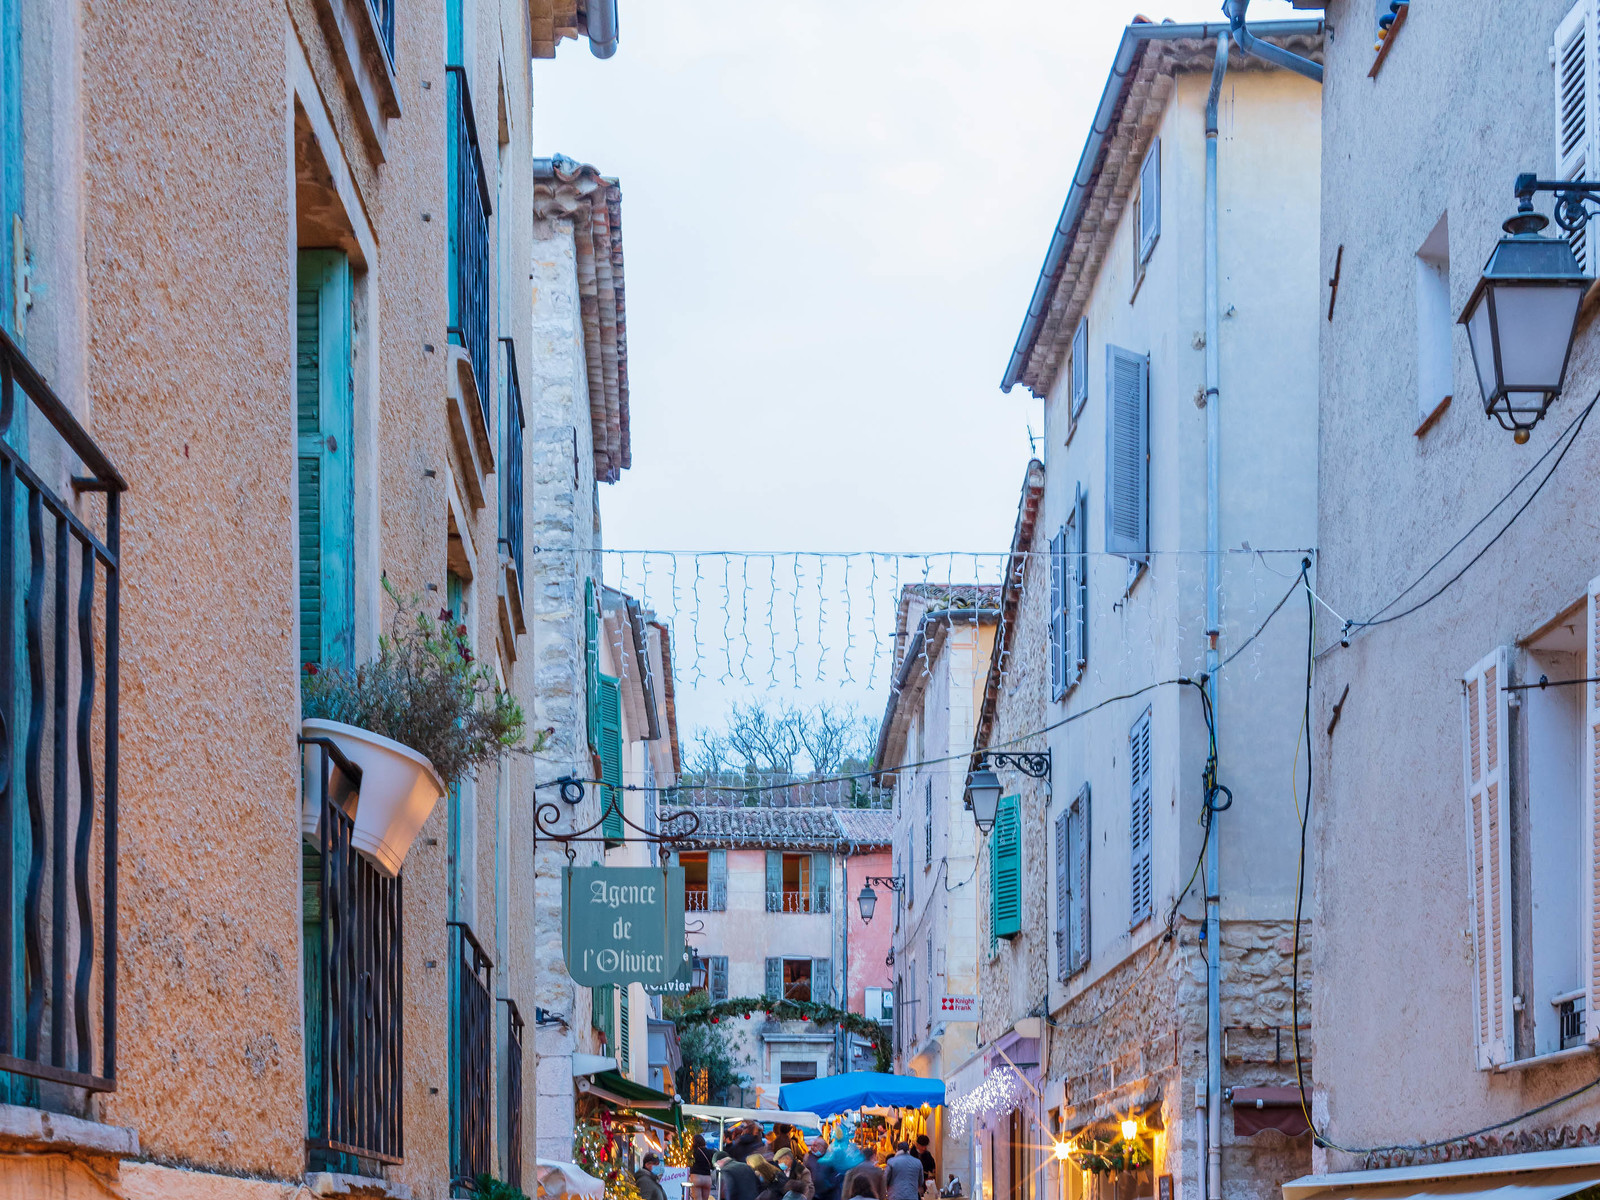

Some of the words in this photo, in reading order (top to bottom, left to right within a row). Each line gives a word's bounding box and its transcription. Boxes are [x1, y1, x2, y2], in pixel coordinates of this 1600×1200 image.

[590, 880, 656, 909] Agence
[613, 917, 632, 940] de
[583, 949, 664, 973] l'Olivier
